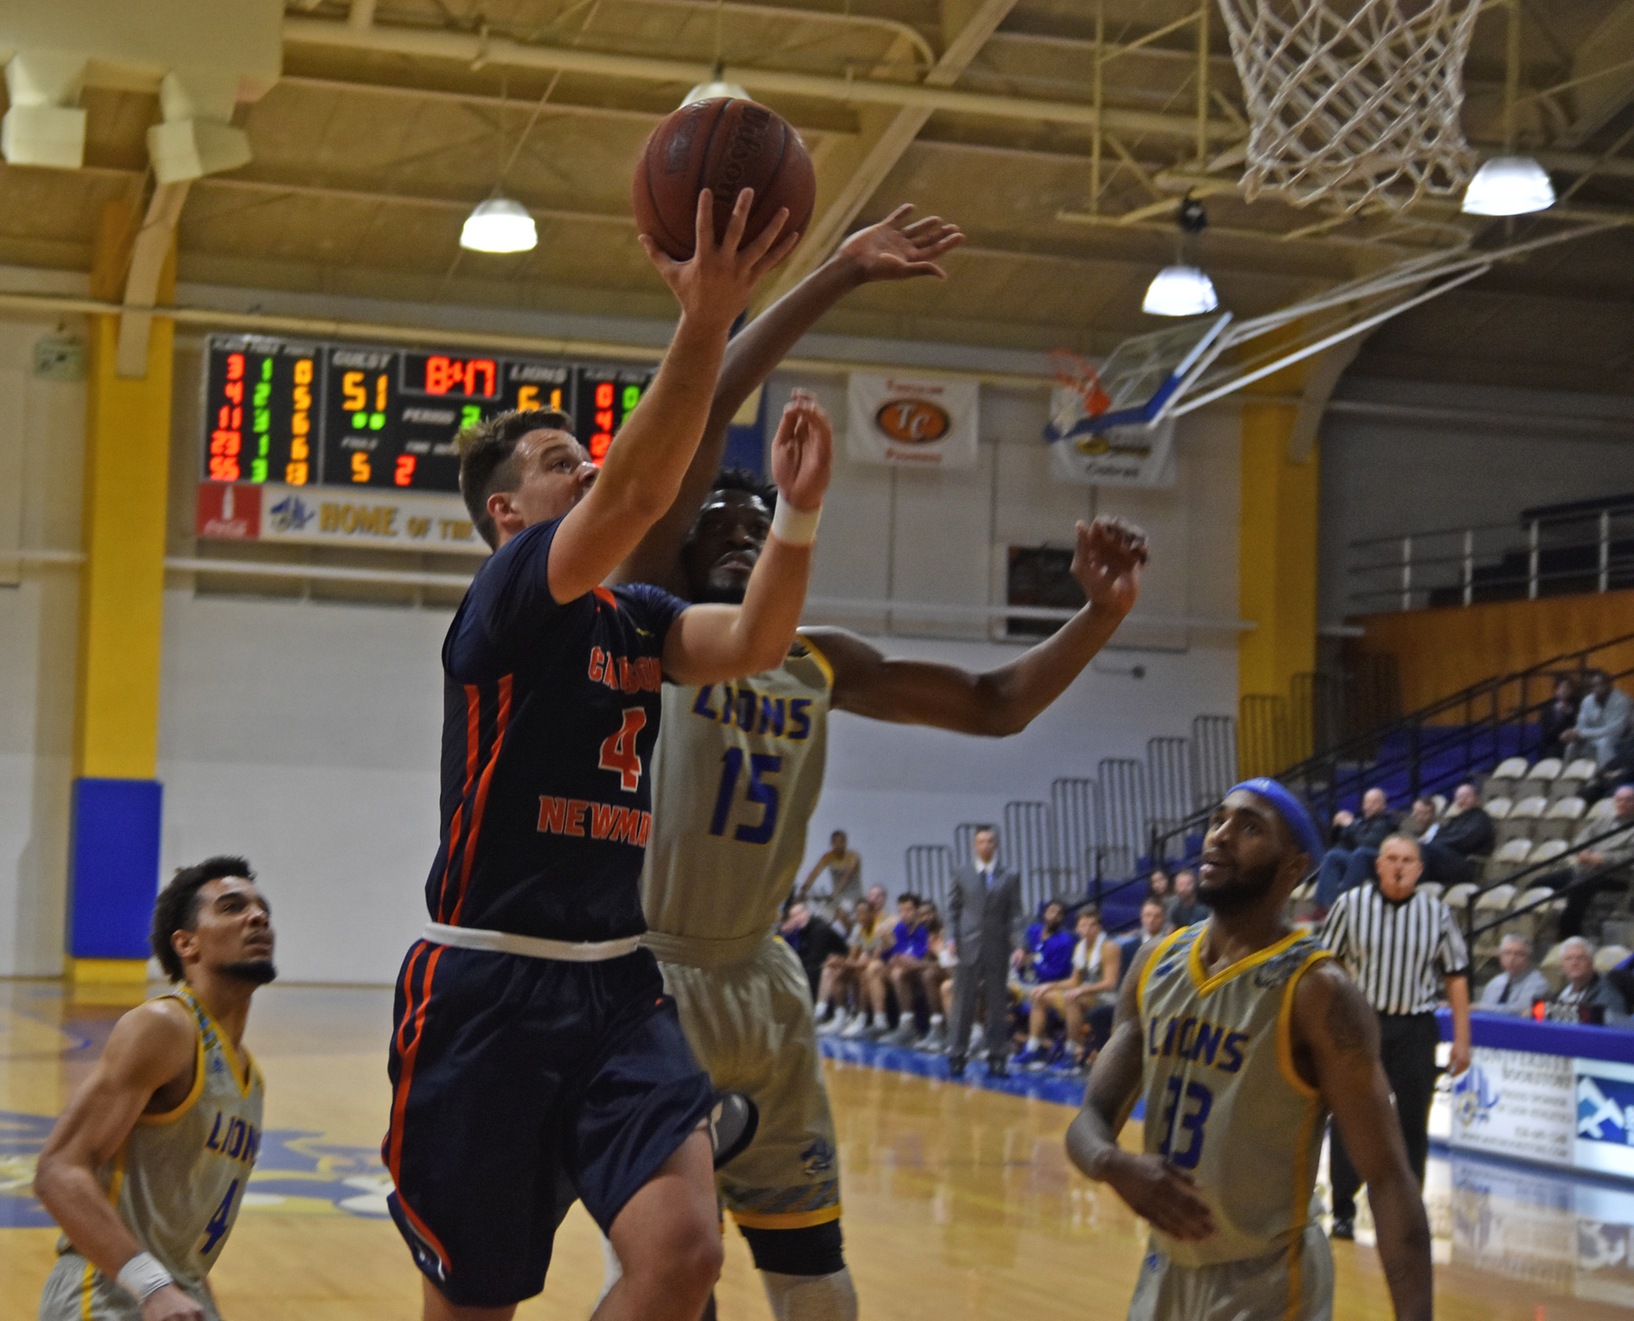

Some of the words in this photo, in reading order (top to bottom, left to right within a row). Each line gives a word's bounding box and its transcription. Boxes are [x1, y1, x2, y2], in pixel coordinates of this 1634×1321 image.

[226, 353, 245, 380] 3
[262, 357, 273, 382] 1
[225, 380, 244, 405] 4
[253, 381, 271, 406] 2
[293, 385, 312, 411] 5
[342, 371, 388, 412] 51
[218, 405, 242, 430] 11
[258, 433, 270, 458] 1
[209, 455, 240, 482] 55
[251, 457, 268, 483] 3
[351, 452, 371, 483] 5
[394, 454, 417, 487] 2
[319, 503, 398, 536] HOME
[406, 516, 431, 538] OF
[693, 682, 813, 740] LIONS
[598, 706, 647, 793] 4
[710, 746, 783, 845] 15
[1149, 1014, 1249, 1074] LIONS
[206, 1110, 261, 1165] LION
[1160, 1075, 1213, 1170] 13
[200, 1178, 239, 1256] 4
